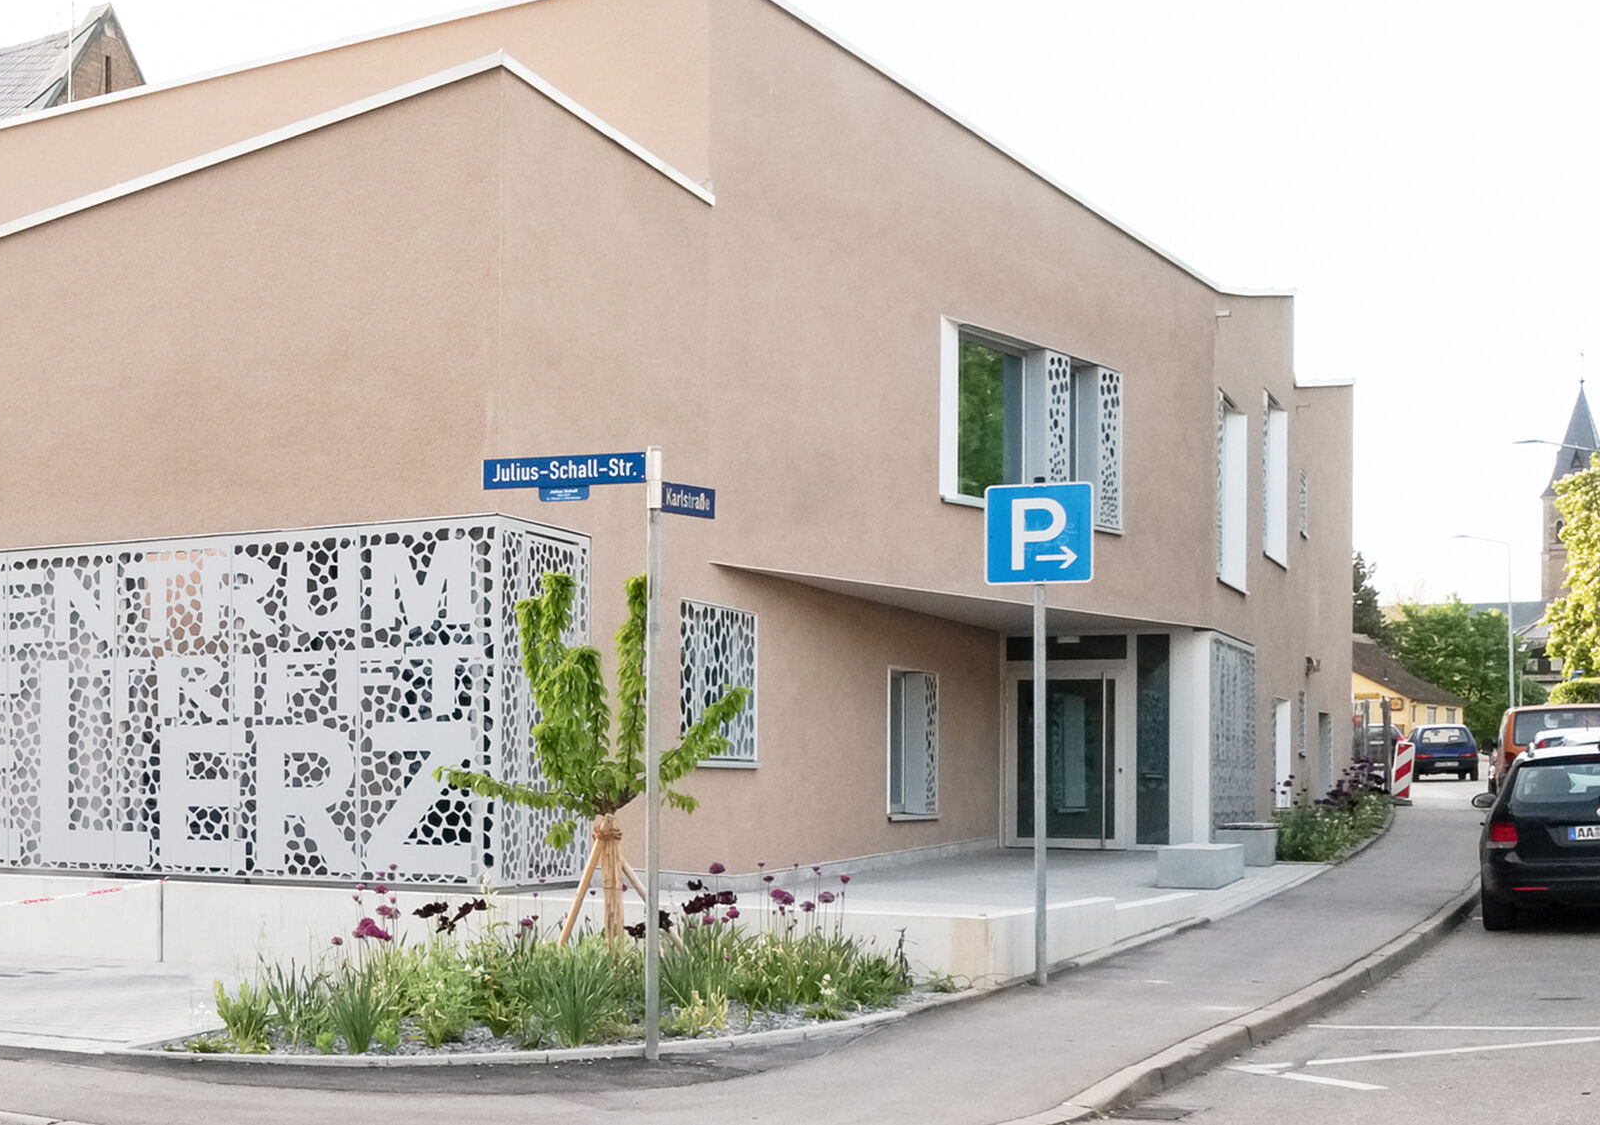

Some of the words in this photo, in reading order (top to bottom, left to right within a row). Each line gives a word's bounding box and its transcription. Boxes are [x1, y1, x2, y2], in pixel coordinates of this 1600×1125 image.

[491, 458, 638, 483] Julius-Schall-Str.
[664, 489, 711, 512] Karlstraße
[1011, 497, 1067, 571] P
[158, 719, 475, 877] ERZ
